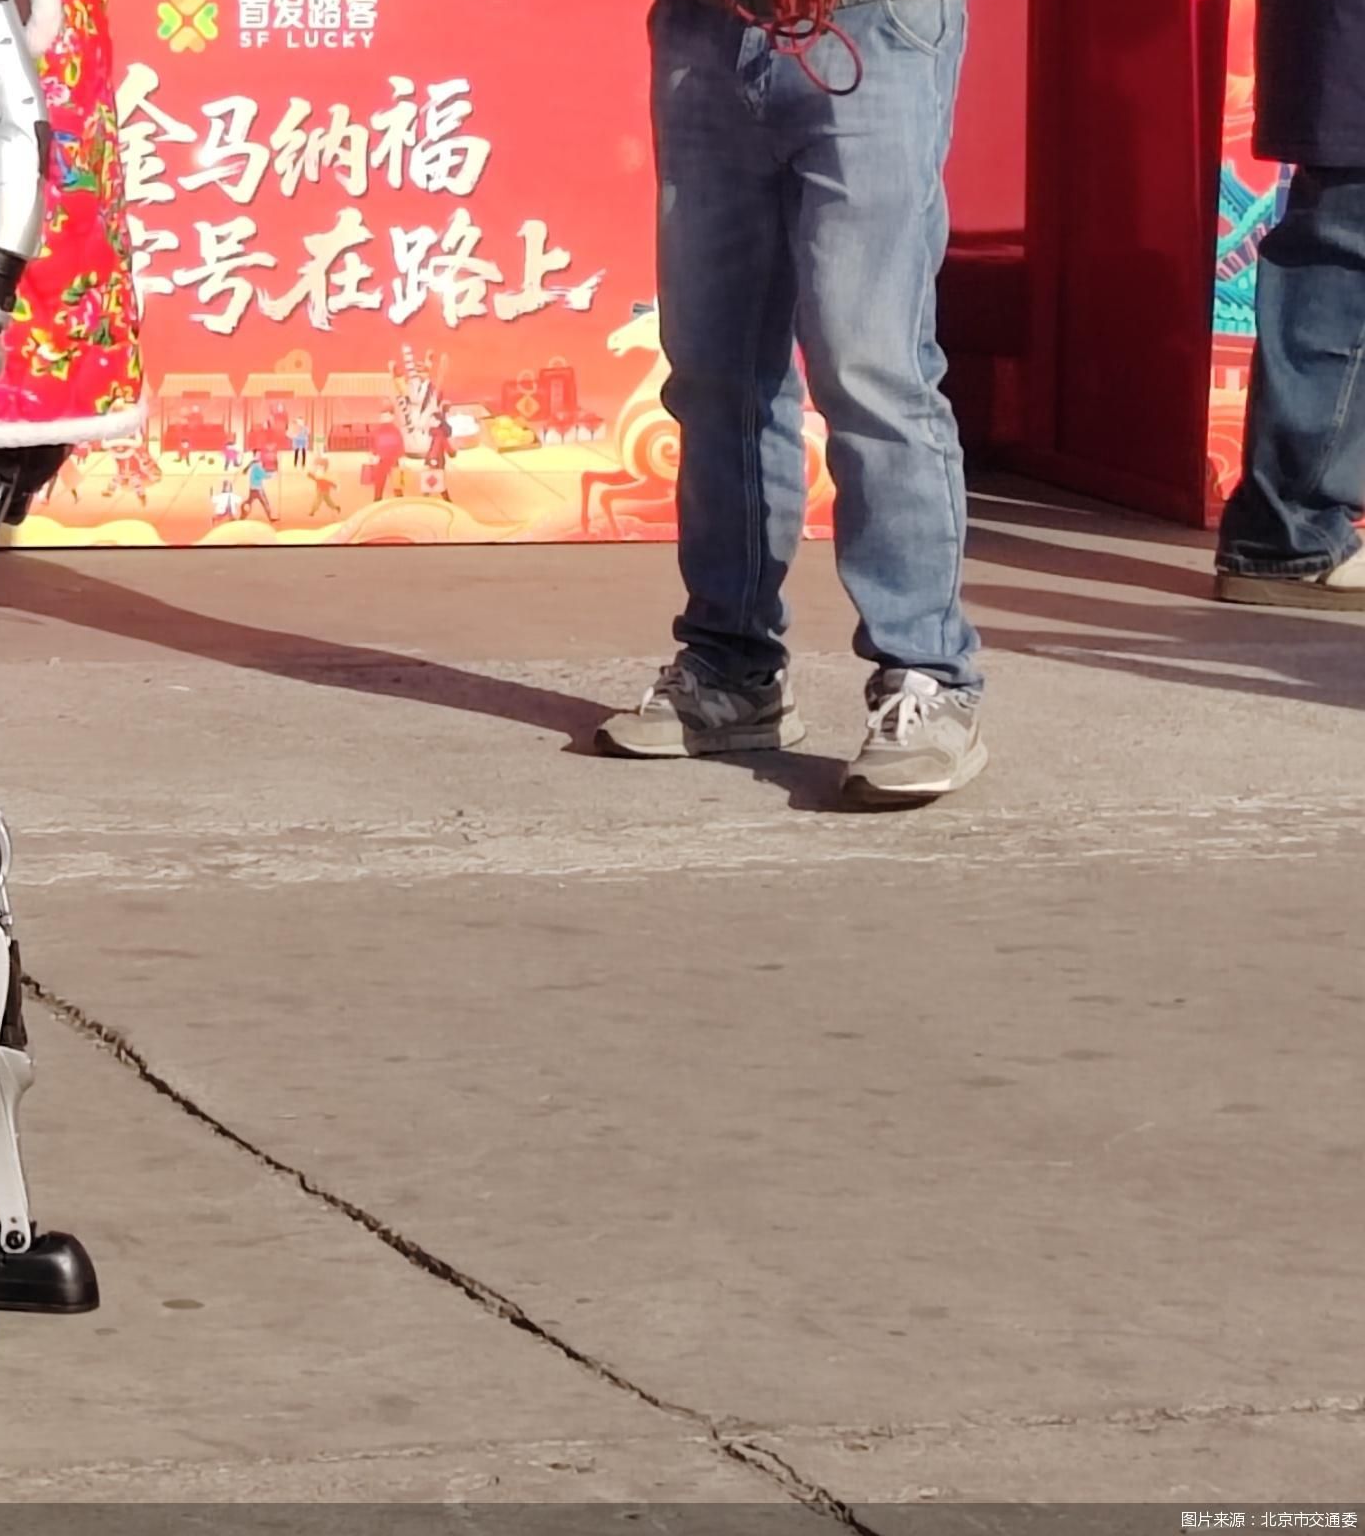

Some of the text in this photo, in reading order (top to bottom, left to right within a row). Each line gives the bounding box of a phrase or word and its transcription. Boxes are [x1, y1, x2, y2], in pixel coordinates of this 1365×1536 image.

[239, 31, 375, 48] SF LUCKY
[115, 63, 491, 206] 金马纳福
